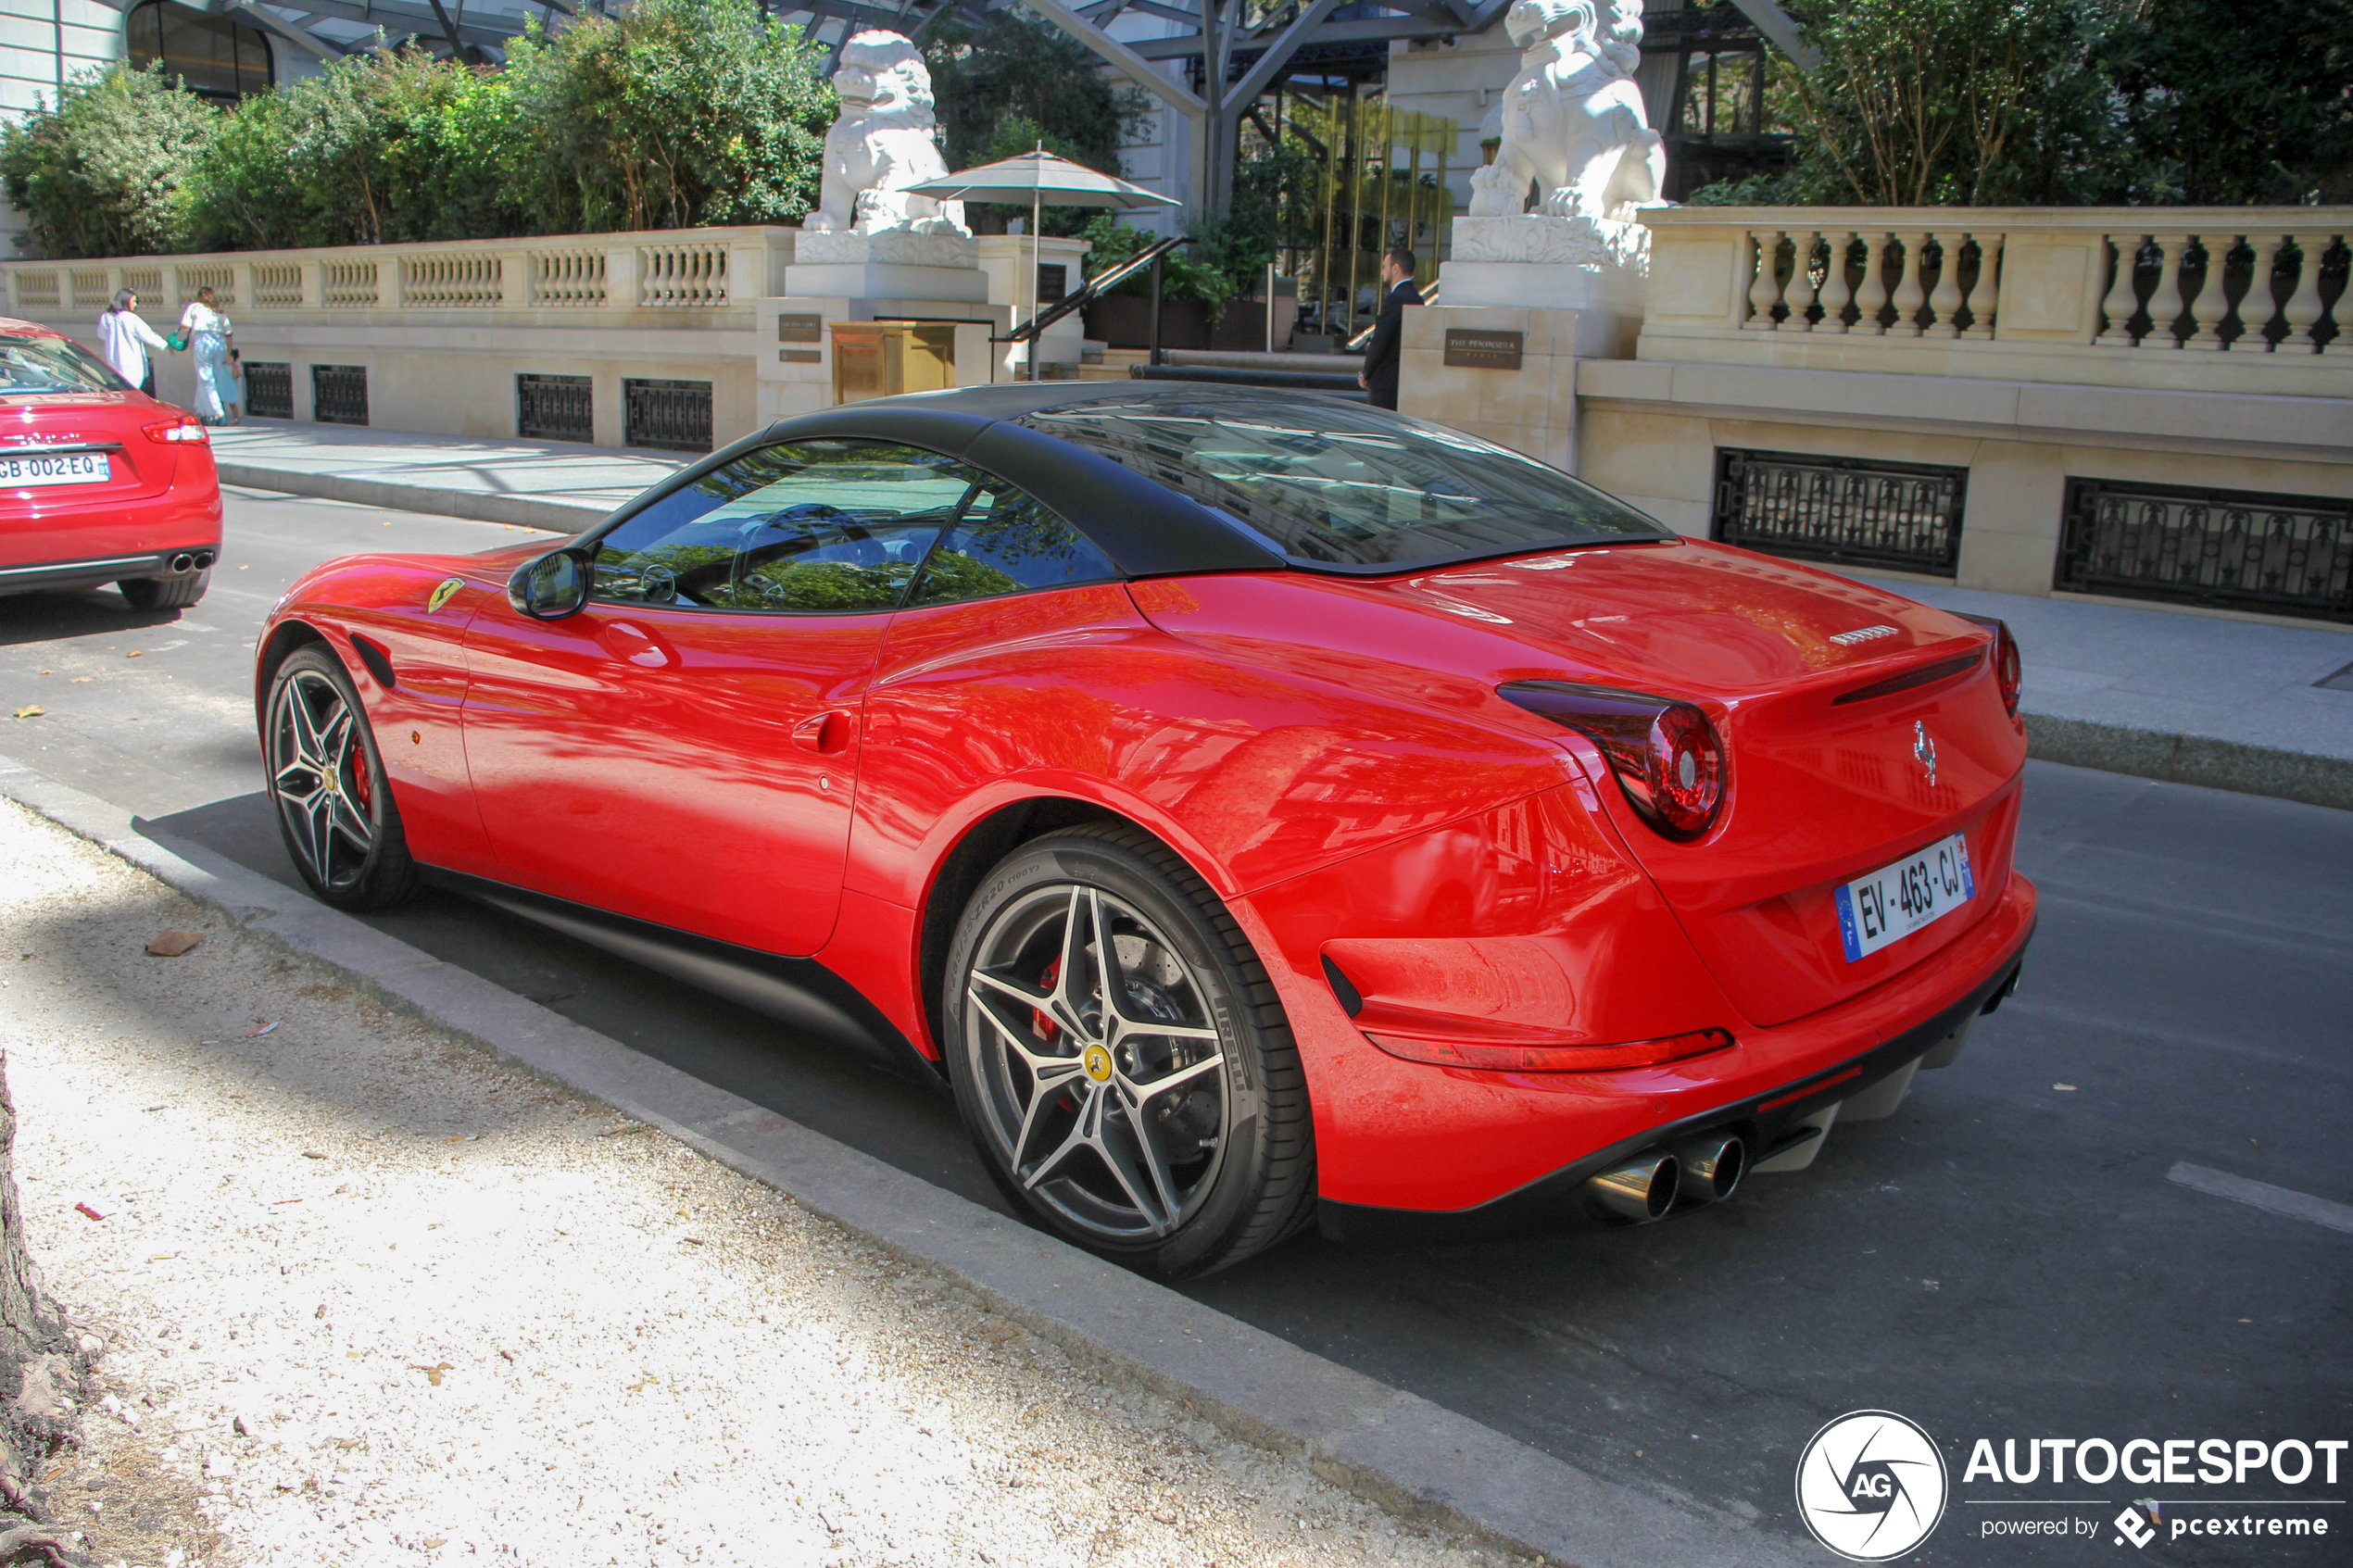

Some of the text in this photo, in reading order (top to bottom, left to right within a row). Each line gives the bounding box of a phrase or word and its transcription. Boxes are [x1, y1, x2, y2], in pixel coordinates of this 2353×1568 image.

[1451, 339, 1515, 349] THE PENINSULA
[98, 464, 109, 474] 91
[1846, 930, 1853, 946] F
